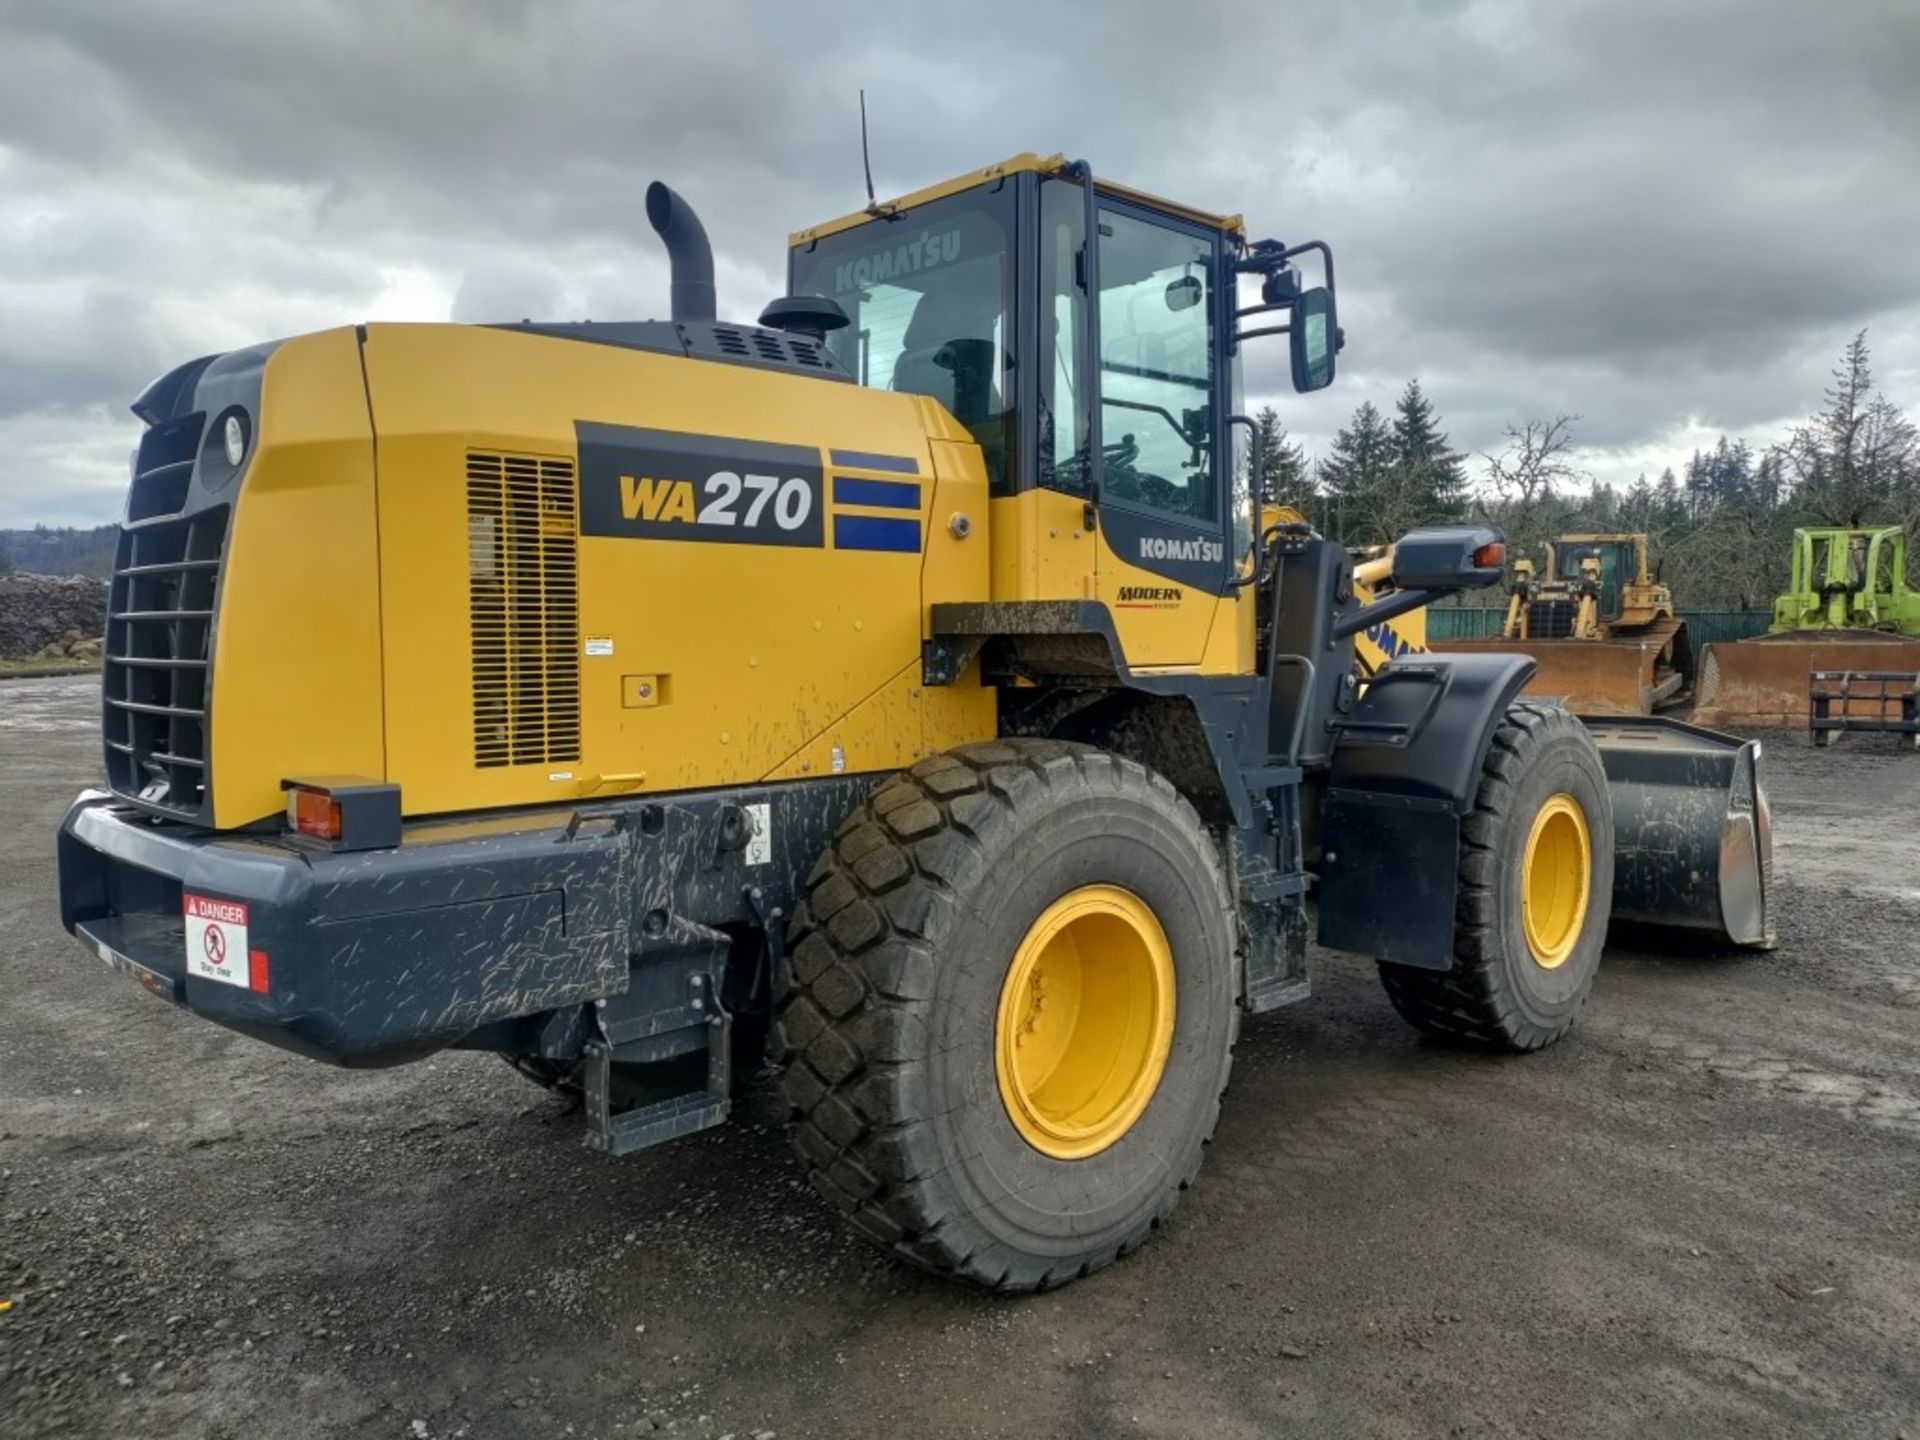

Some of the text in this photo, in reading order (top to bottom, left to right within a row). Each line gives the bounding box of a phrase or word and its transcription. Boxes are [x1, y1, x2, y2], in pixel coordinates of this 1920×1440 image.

[836, 229, 960, 293] KOMATSU
[619, 471, 812, 530] WA270
[1140, 536, 1223, 562] KOMATSU
[1117, 586, 1183, 601] MODERN
[200, 901, 244, 924] DANGER
